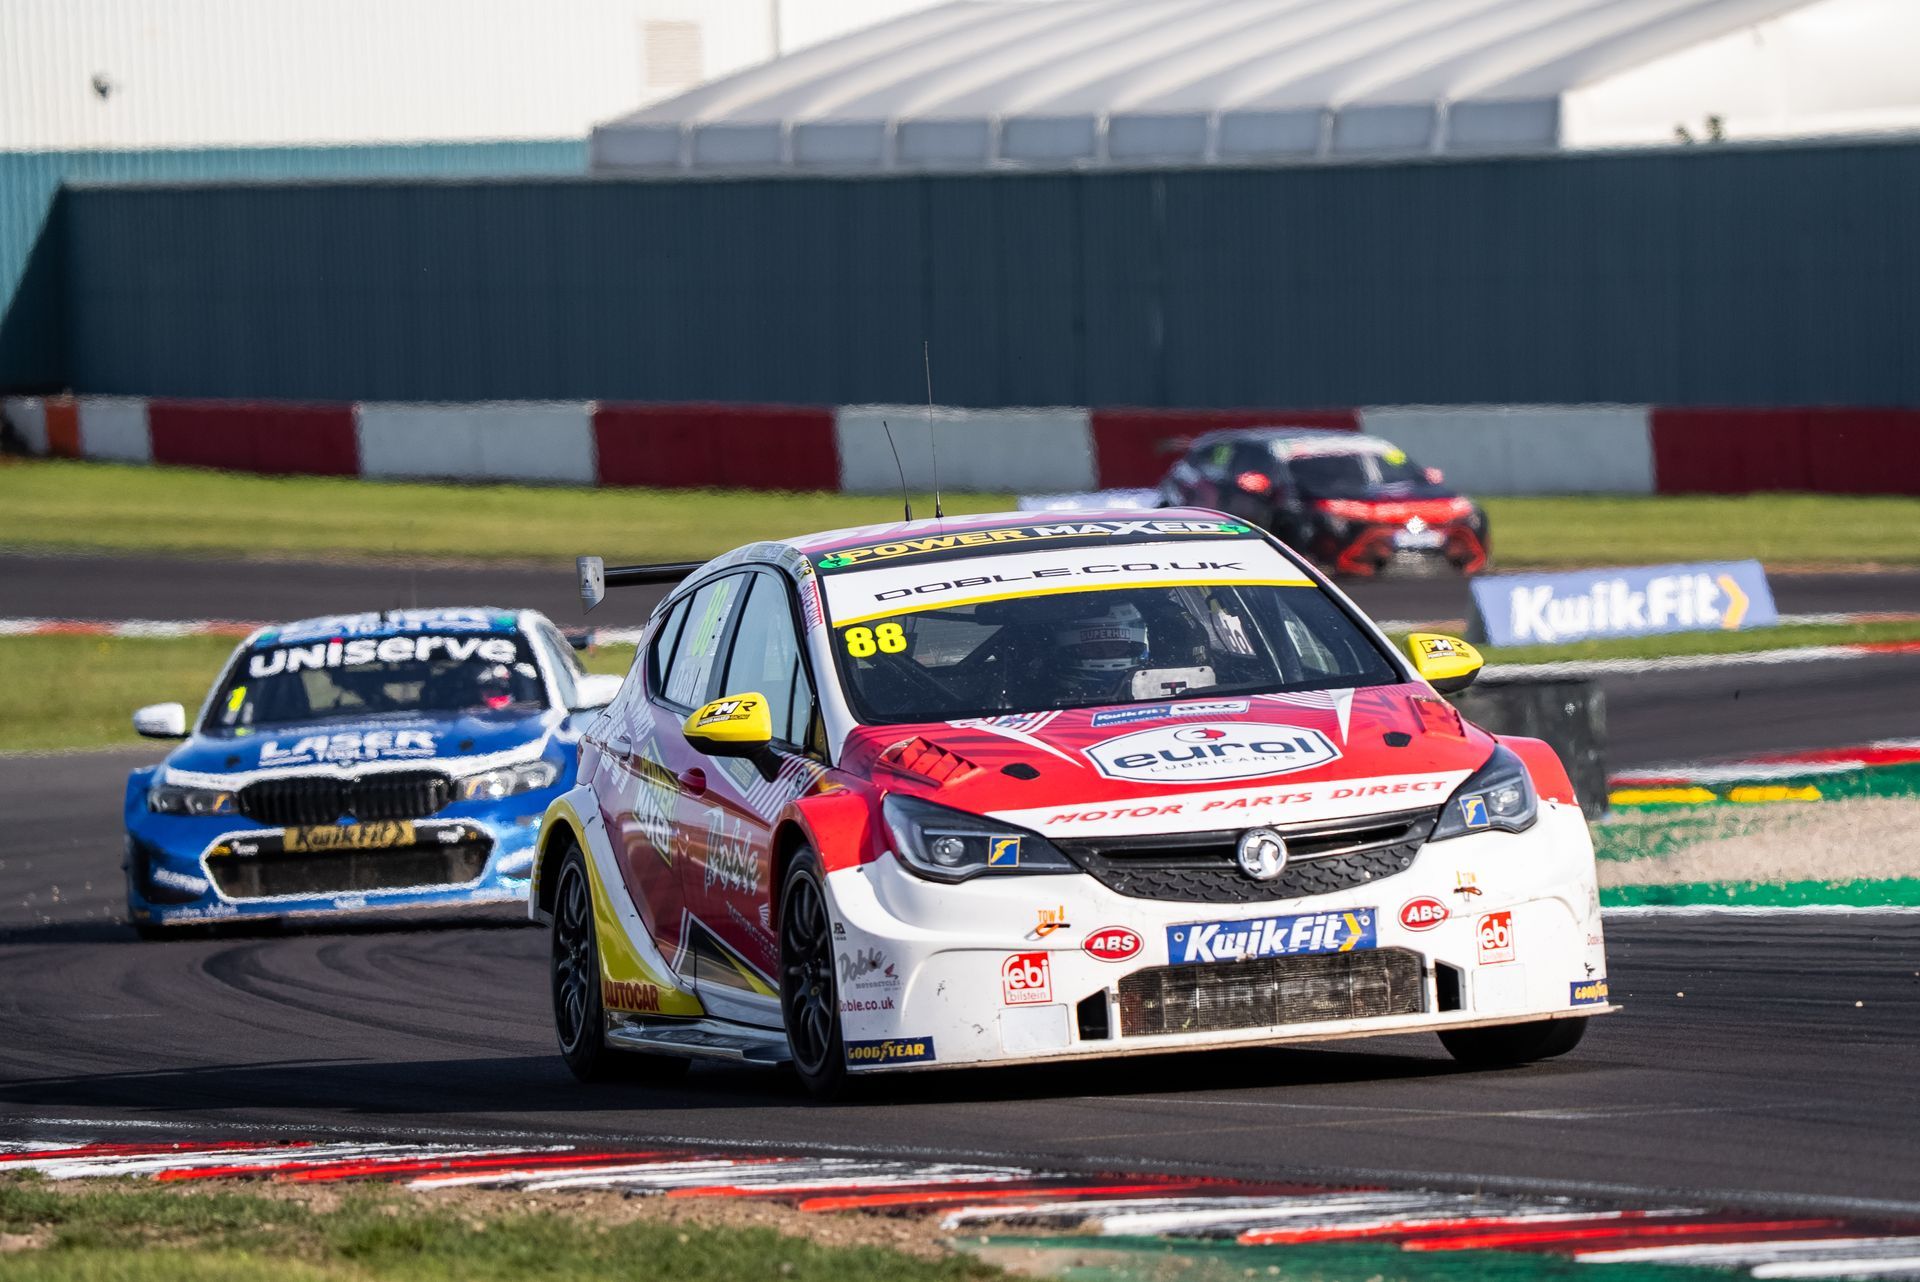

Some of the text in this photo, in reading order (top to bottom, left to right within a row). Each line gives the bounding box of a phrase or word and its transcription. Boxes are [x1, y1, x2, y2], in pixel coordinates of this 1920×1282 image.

[846, 520, 1226, 562] POWER MAXED
[873, 561, 1247, 602] DOBLE.CO.UK
[844, 622, 907, 658] 88
[701, 700, 757, 719] PMR
[1113, 737, 1316, 769] eurol
[1149, 755, 1297, 773] LUBRICANTS
[1046, 781, 1447, 825] MOTOR PARTS DIRECT
[1037, 910, 1056, 923] TOW
[1406, 905, 1445, 922] ABS
[1092, 935, 1136, 951] ABS
[1183, 913, 1342, 962] KwikFit
[1477, 914, 1512, 949] febi
[1002, 955, 1049, 989] febi
[604, 980, 660, 1011] AUTOCAR
[1008, 990, 1047, 1001] bilstein
[847, 1043, 925, 1061] GOODYEAR
